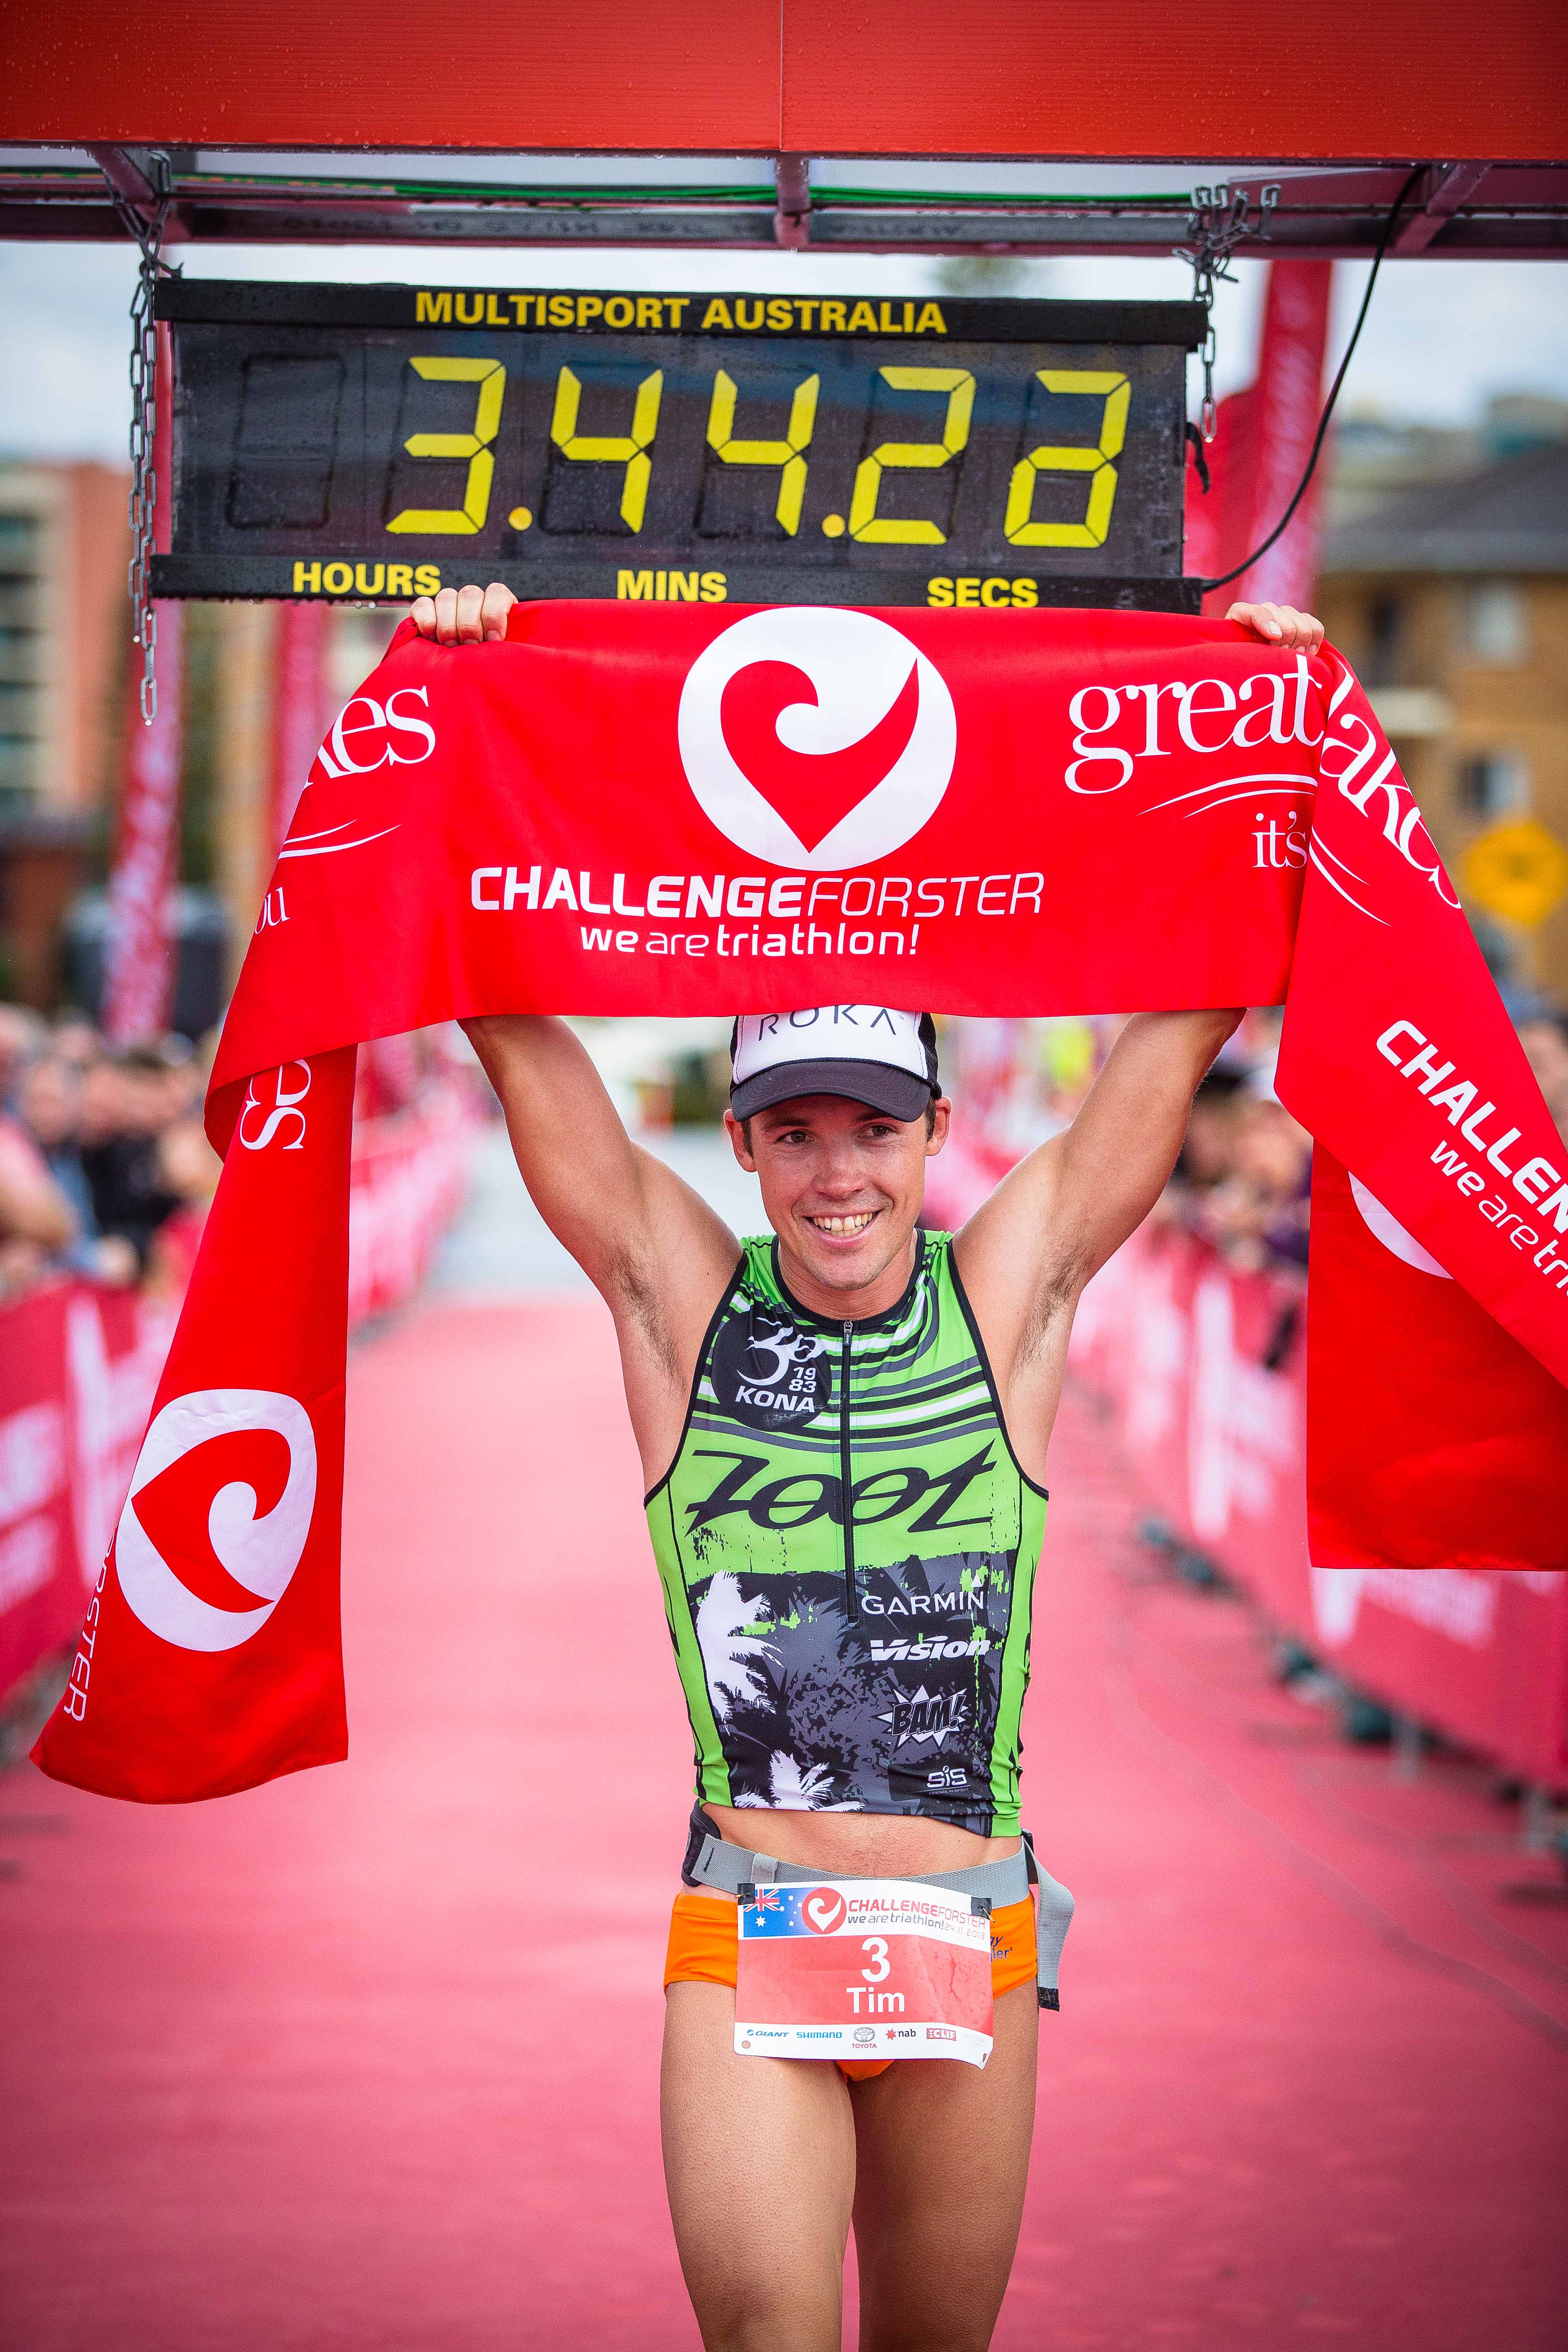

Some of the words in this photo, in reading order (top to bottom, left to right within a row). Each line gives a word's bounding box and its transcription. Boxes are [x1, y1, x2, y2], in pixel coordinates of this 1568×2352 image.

[416, 292, 690, 328] MULTISPORT
[702, 298, 947, 333] AUSTRALIA
[293, 561, 441, 597] HOURS
[616, 569, 728, 603] MINS
[927, 577, 1039, 608] SECS
[1064, 654, 1324, 794] great
[1251, 811, 1308, 868] it's
[580, 927, 639, 953] we
[646, 932, 709, 957] are
[716, 923, 920, 957] triathlon!
[758, 1004, 896, 1041] ROKA
[1430, 1140, 1486, 1197] we
[1478, 1195, 1539, 1251] are
[788, 1379, 817, 1393] 83
[793, 1367, 816, 1380] 19
[735, 1385, 815, 1413] KONA
[861, 1590, 984, 1616] GARMIN
[870, 1635, 991, 1662] Vision
[891, 1695, 967, 1736] BAM!
[848, 1915, 866, 1924] we
[868, 1914, 889, 1923] are
[891, 1913, 944, 1930] triathlon!
[944, 1923, 985, 1940] 24.11.2013
[861, 1937, 891, 1983] 3
[846, 1987, 905, 2013] Tim
[898, 2029, 916, 2037] nab
[933, 2029, 956, 2039] CLIF
